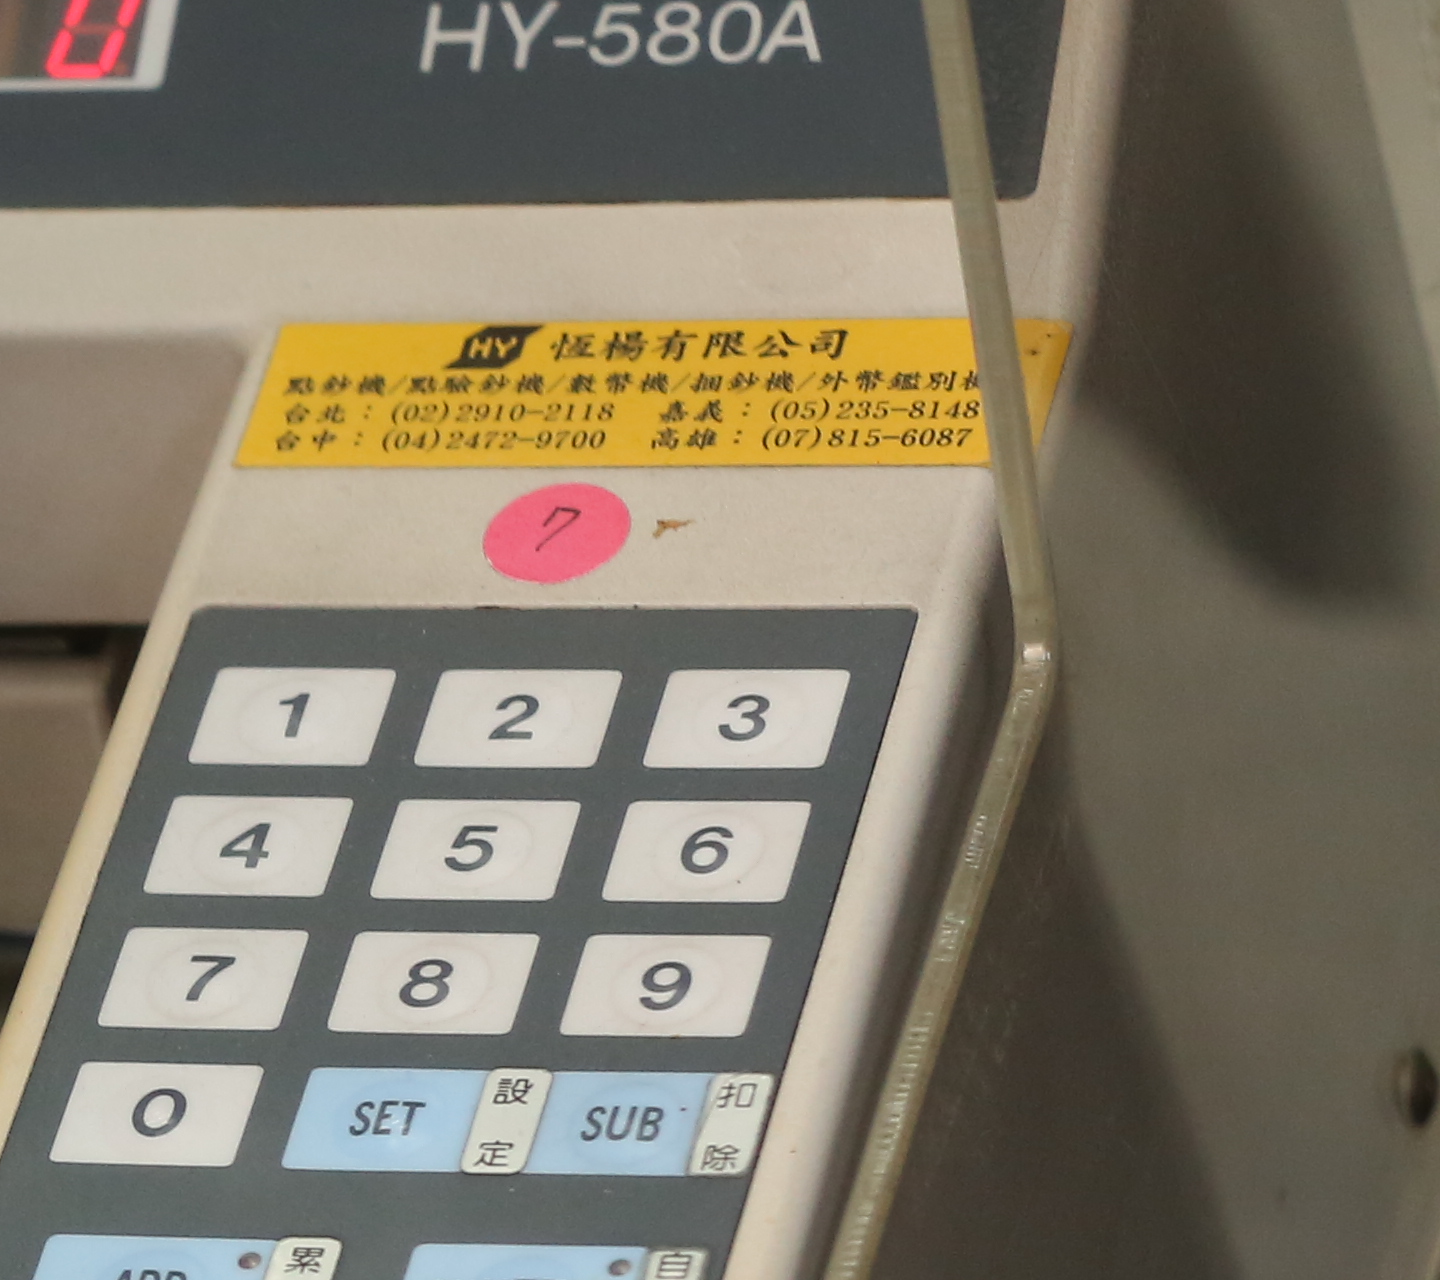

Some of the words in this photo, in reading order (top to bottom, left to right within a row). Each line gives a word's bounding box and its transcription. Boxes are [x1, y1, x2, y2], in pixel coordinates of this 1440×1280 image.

[468, 336, 520, 360] HY
[535, 506, 582, 553] 7
[279, 691, 311, 740] 1
[489, 693, 541, 742] 2
[718, 693, 772, 744] 3
[219, 822, 272, 871] 4
[444, 824, 499, 874] 5
[681, 825, 735, 876] 6
[185, 955, 237, 1004] 7
[399, 958, 454, 1010] 8
[639, 961, 693, 1012] 9
[349, 1099, 427, 1137] SET
[473, 1077, 535, 1168] 設定
[580, 1104, 666, 1143] SUB
[702, 1081, 758, 1173] 扣除
